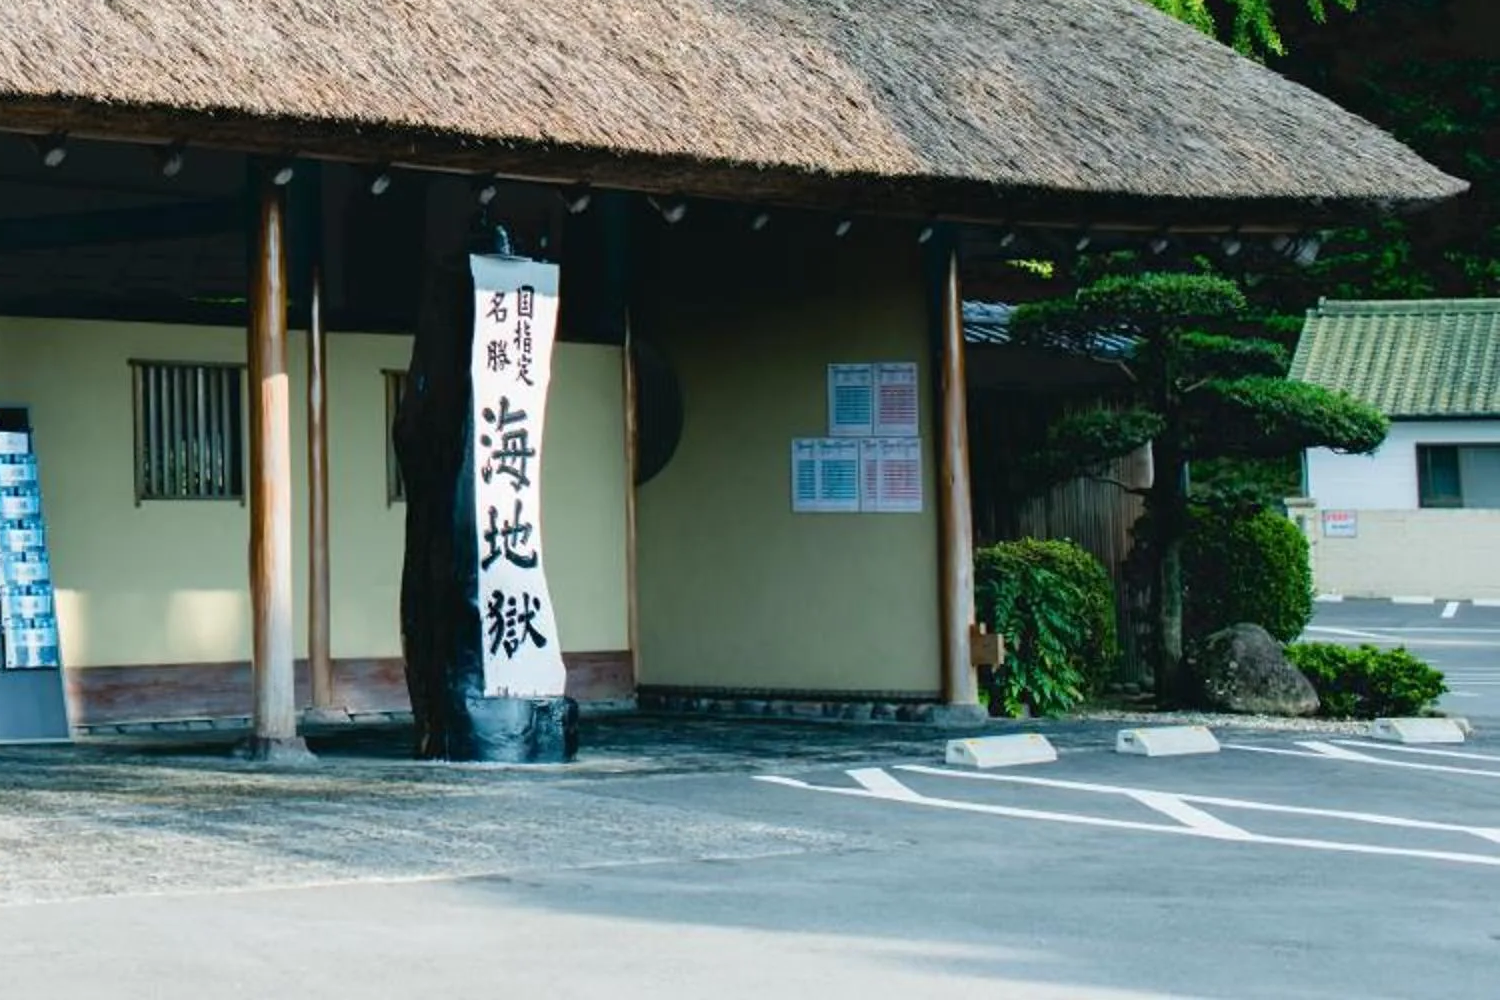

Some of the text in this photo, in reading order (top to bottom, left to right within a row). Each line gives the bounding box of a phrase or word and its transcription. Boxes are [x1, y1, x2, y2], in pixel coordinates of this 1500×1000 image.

[486, 291, 511, 372] 名勝
[513, 285, 535, 386] 国指定
[481, 395, 547, 659] 海地獄
